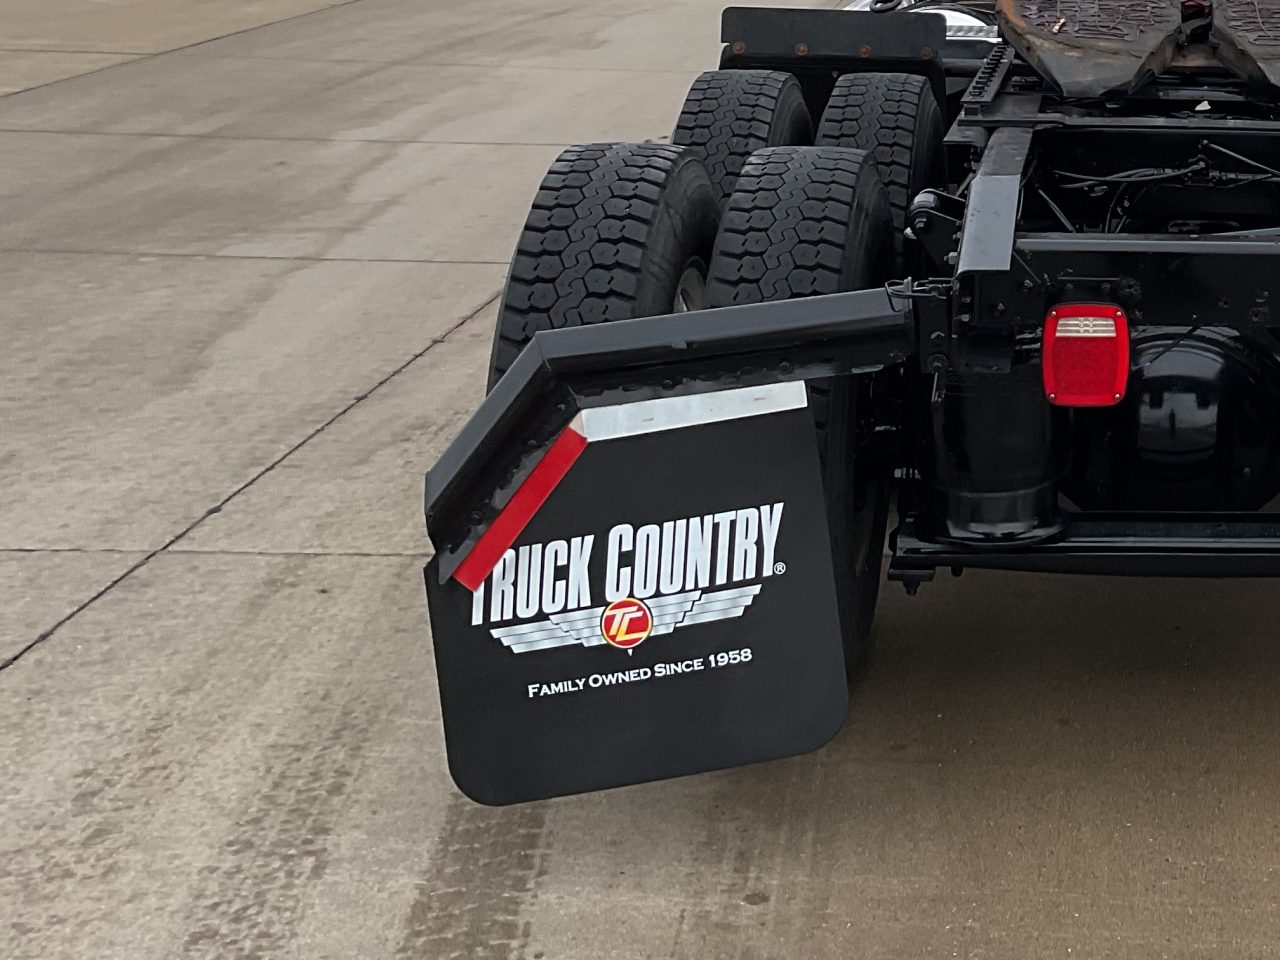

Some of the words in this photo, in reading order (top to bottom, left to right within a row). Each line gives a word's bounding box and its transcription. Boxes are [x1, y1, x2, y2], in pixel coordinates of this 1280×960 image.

[604, 501, 785, 602] COUNTRY
[528, 677, 586, 698] FAMILY
[589, 667, 651, 688] OWNED
[654, 657, 704, 678] SINCE
[708, 647, 753, 668] 1958
